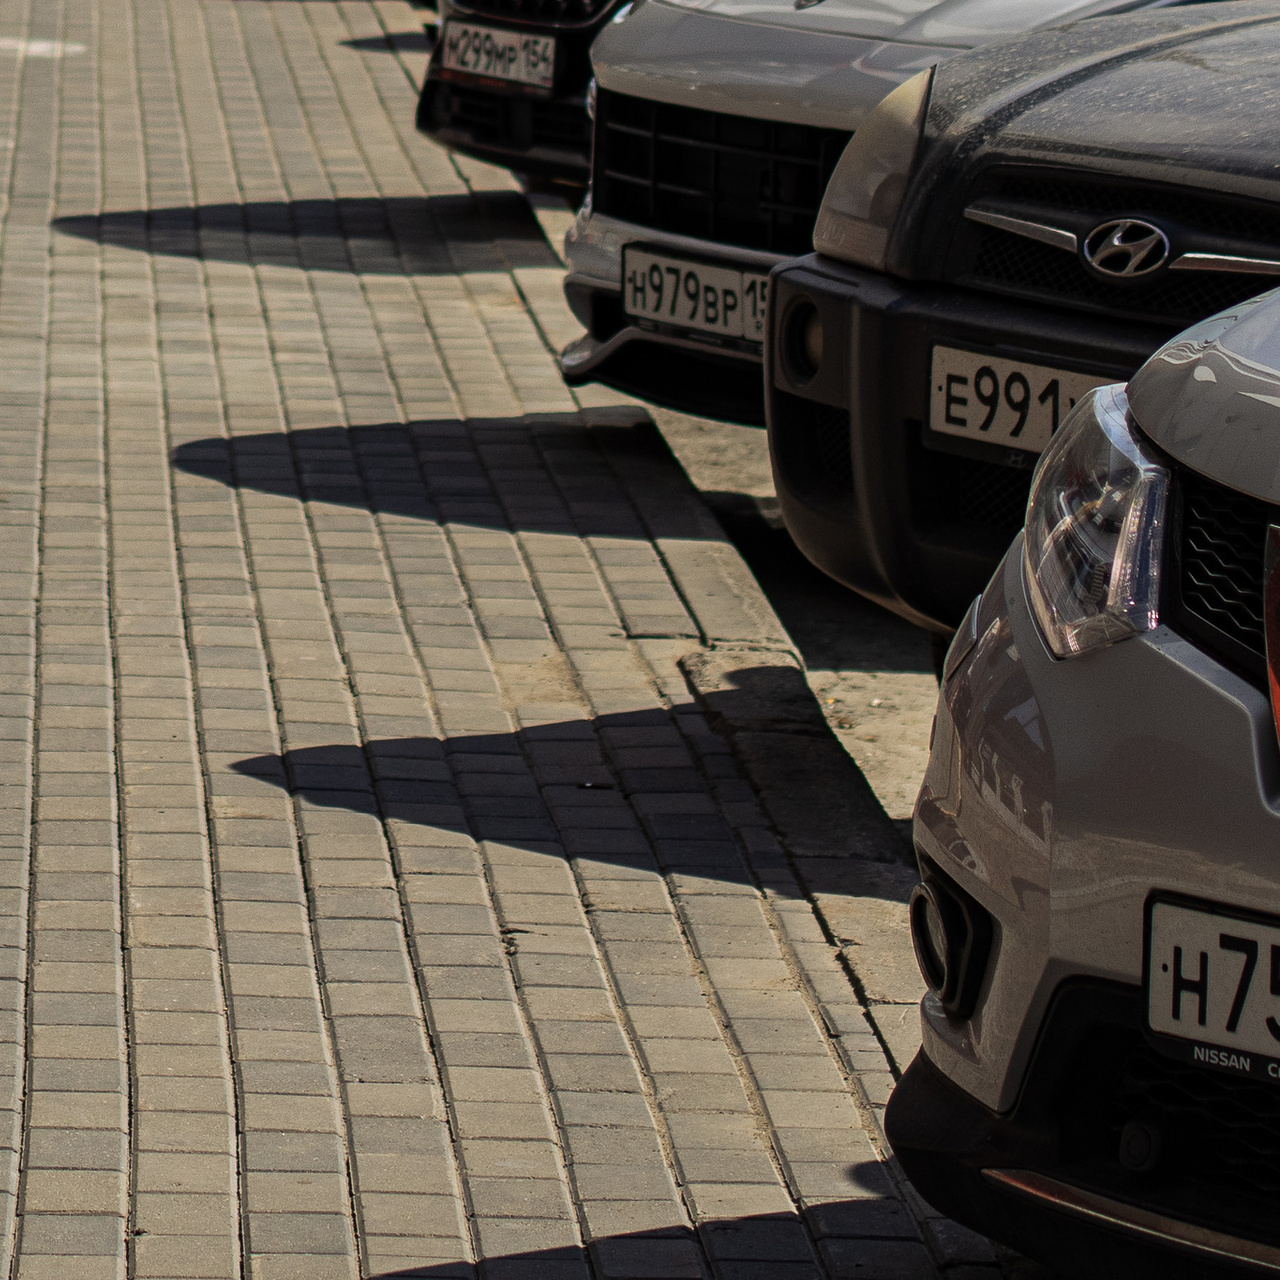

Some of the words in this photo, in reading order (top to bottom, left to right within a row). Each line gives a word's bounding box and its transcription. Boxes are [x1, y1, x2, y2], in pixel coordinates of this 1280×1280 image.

[632, 263, 738, 327] Н979ВР
[945, 365, 1078, 438] Е991
[1193, 1045, 1251, 1072] NISSAN
